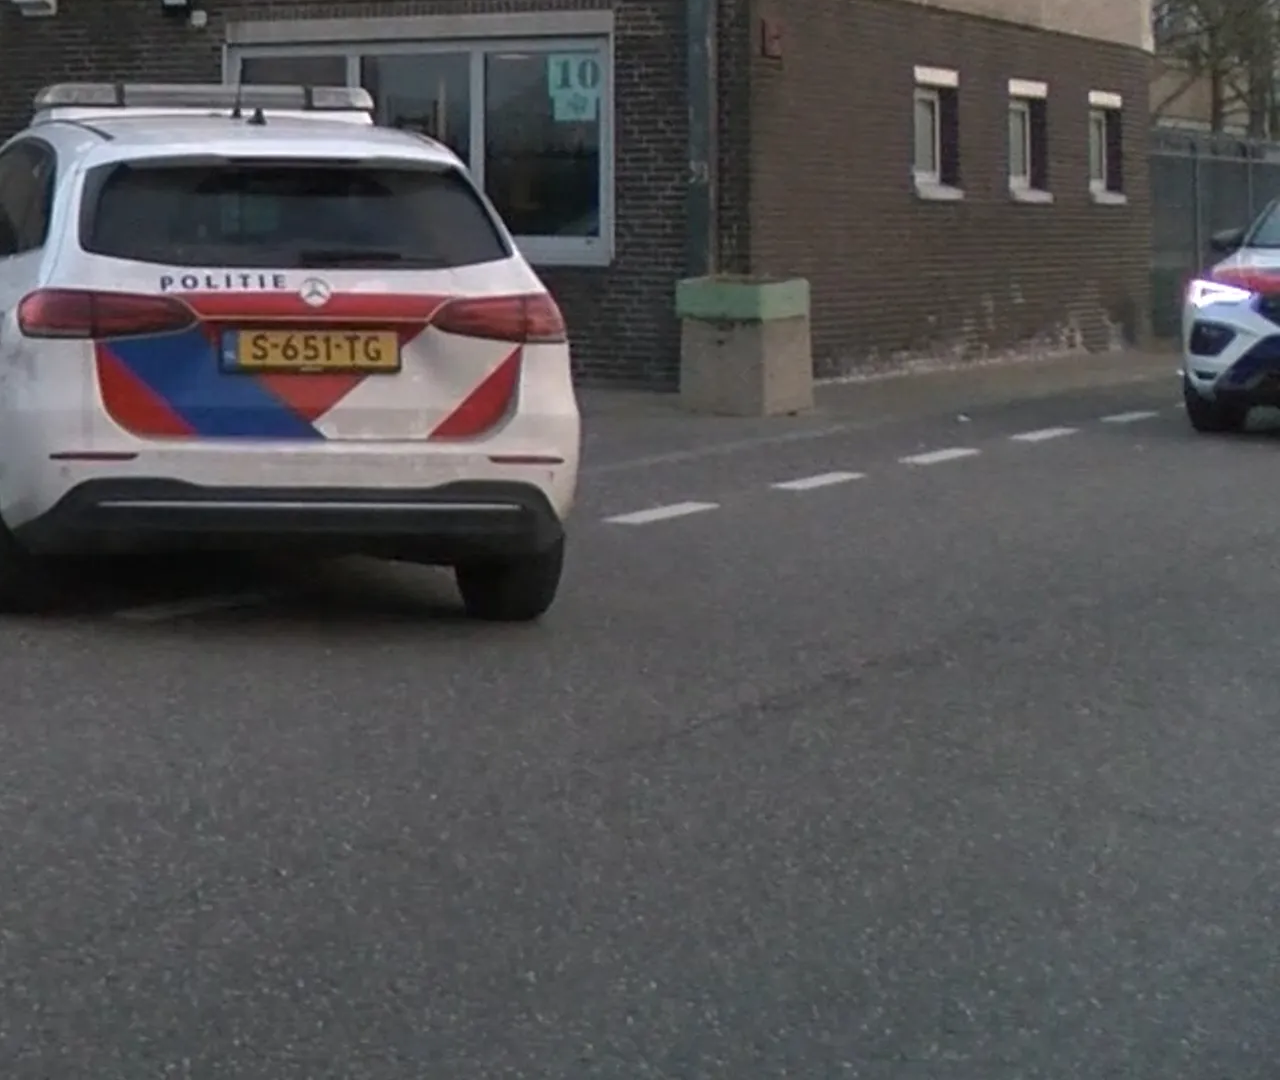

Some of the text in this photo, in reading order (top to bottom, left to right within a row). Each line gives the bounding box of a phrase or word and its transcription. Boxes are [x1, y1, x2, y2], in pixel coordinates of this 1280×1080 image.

[555, 59, 601, 89] 10
[159, 274, 287, 291] POLITIE
[251, 334, 382, 362] S-651-TG
